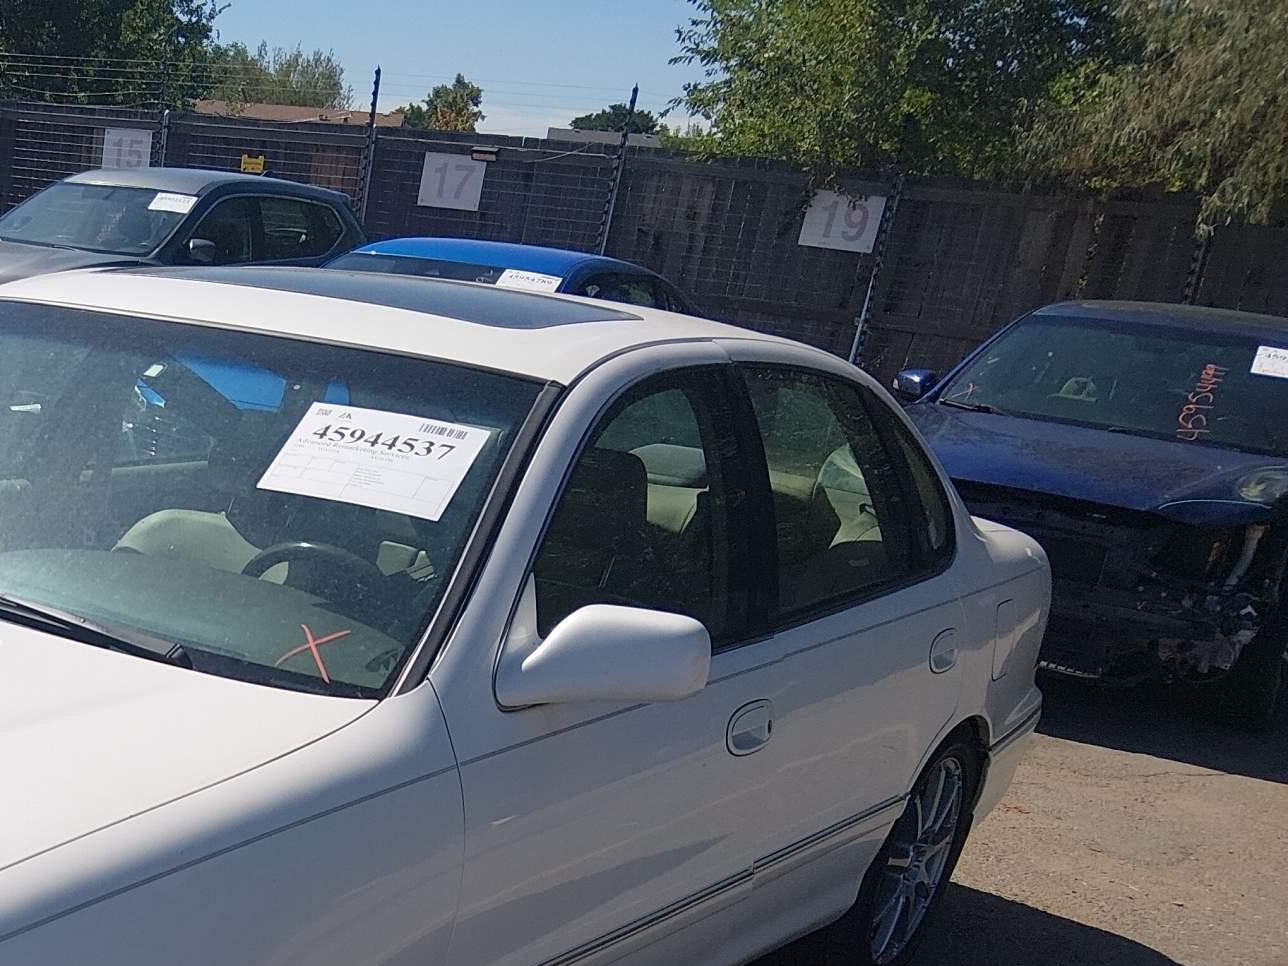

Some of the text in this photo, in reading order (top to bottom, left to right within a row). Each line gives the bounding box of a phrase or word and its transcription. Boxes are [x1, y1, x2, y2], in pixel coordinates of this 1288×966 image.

[115, 137, 144, 168] 15
[434, 161, 476, 200] 17
[821, 200, 869, 242] 19
[312, 423, 456, 460] 45944537
